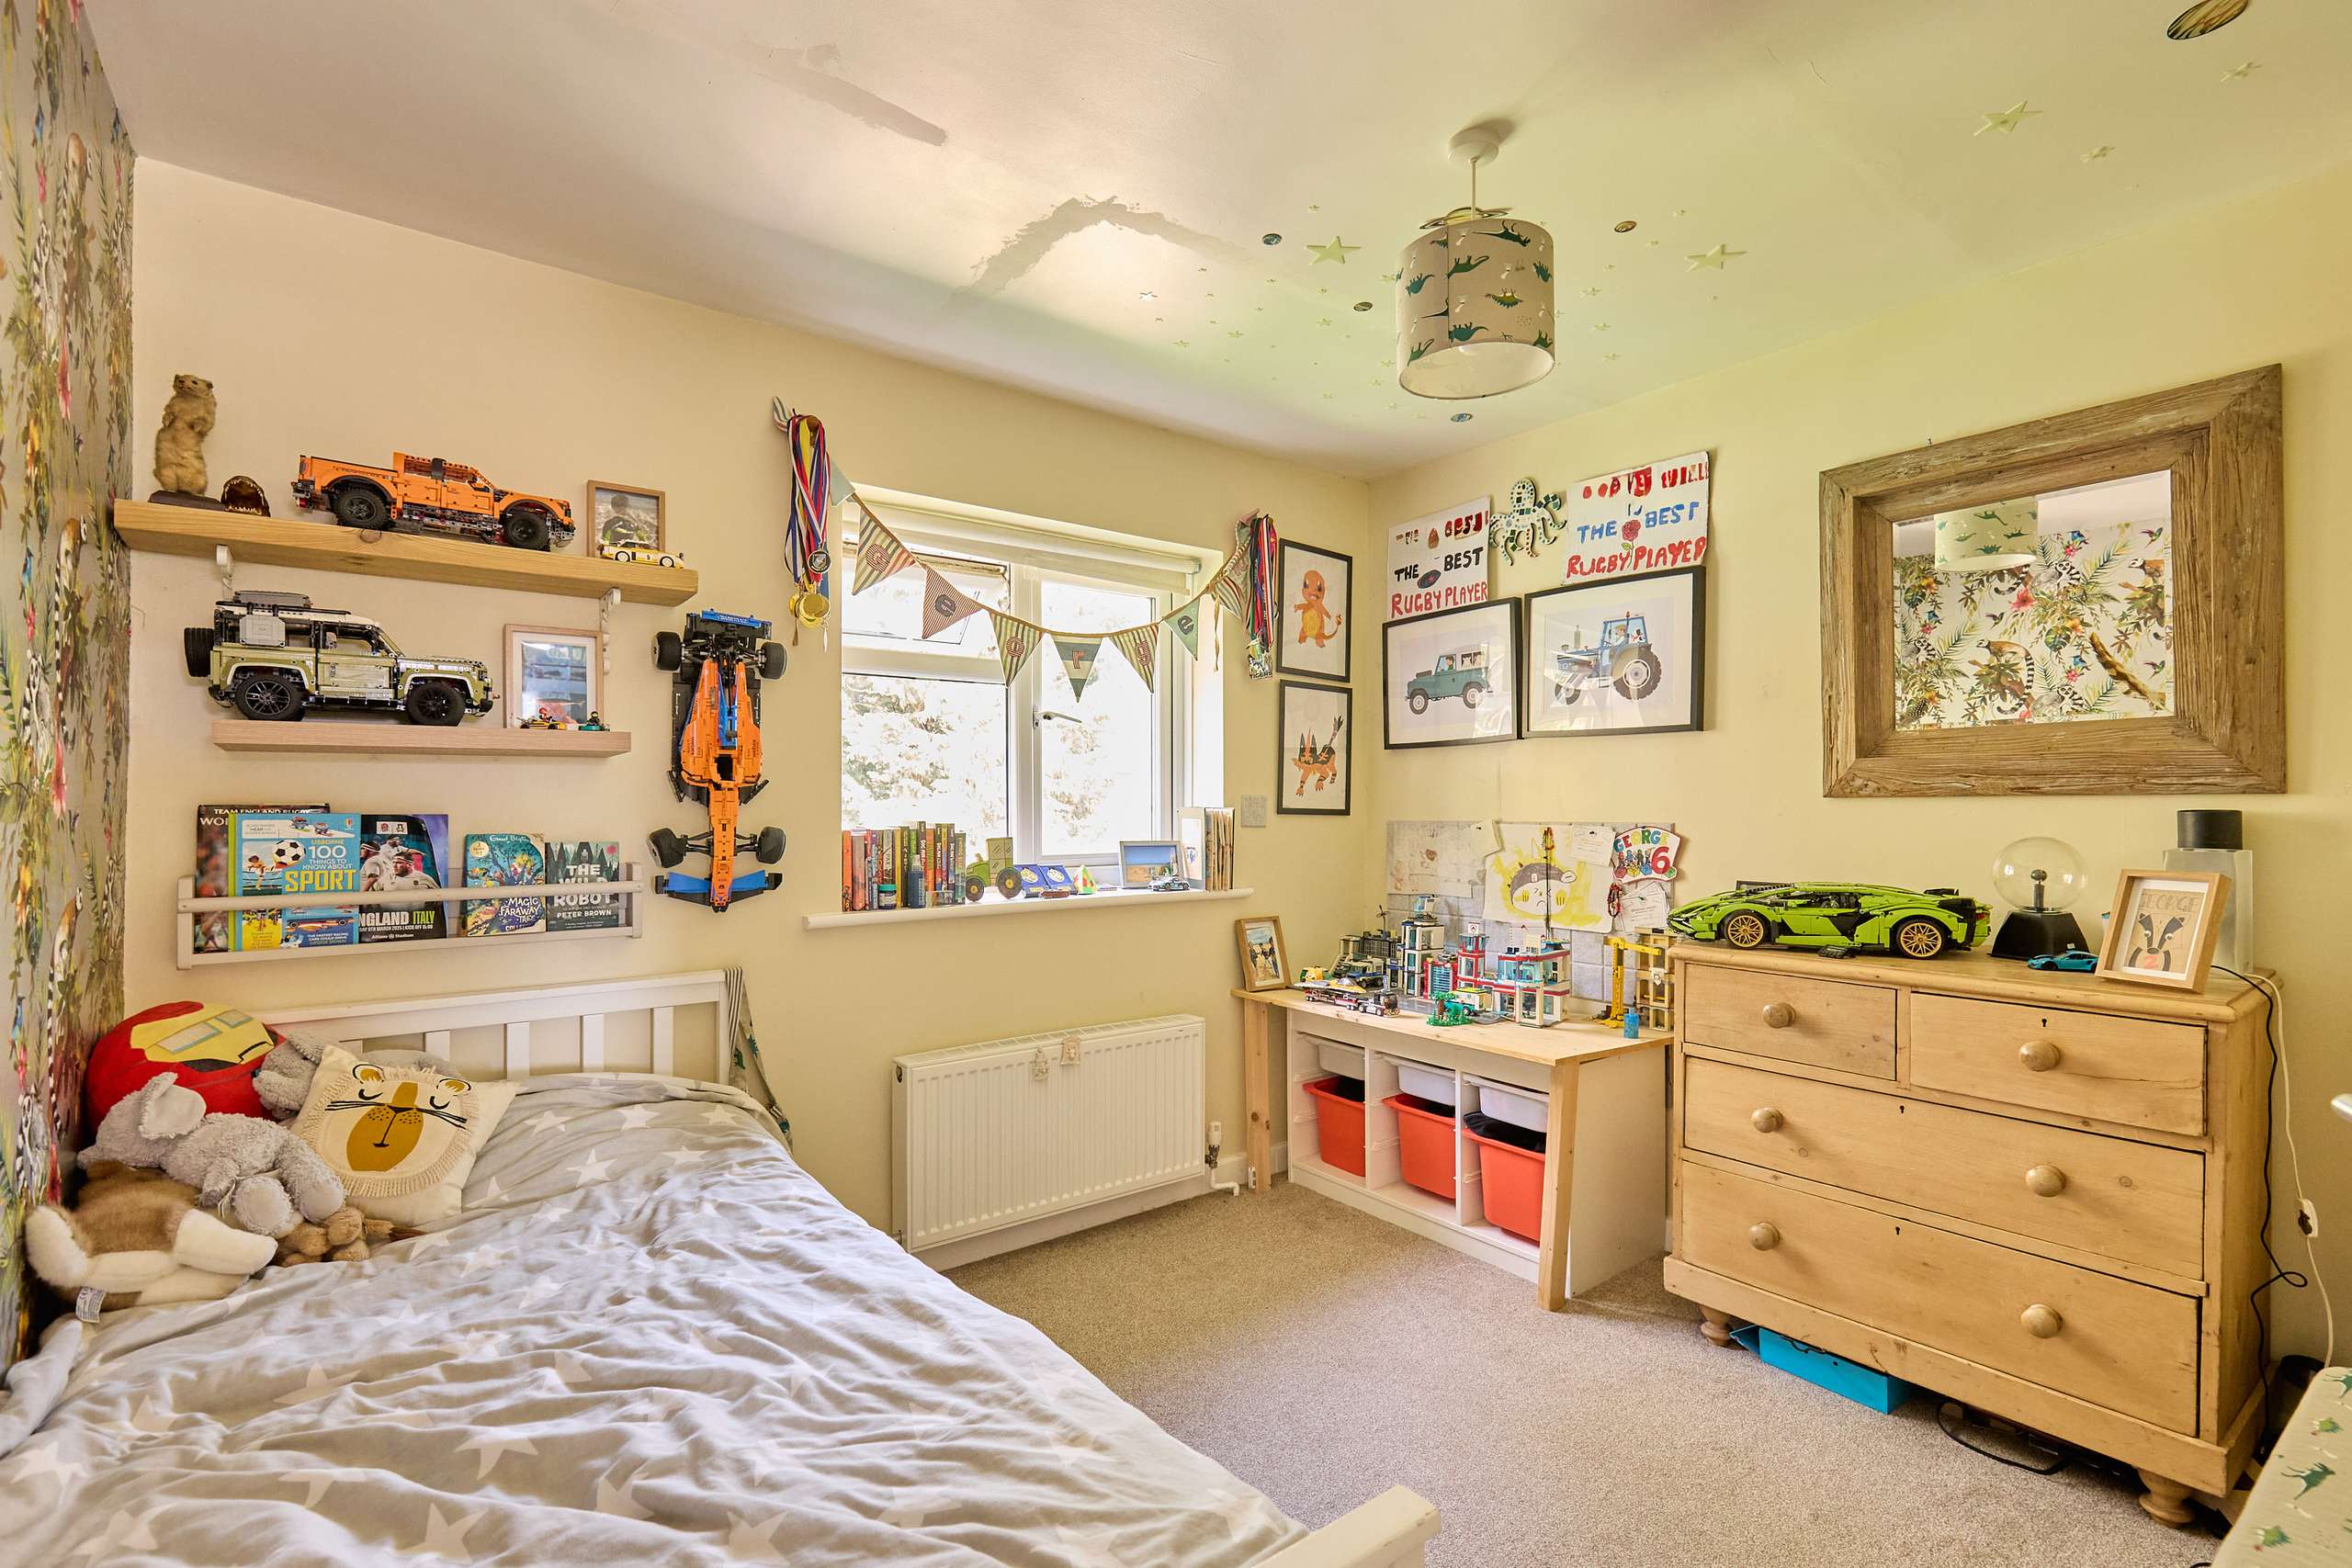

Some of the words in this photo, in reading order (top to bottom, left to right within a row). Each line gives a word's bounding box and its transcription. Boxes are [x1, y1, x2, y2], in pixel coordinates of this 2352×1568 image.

[1577, 520, 1618, 544] THE
[1645, 502, 1700, 529] BEST
[1395, 563, 1419, 581] THE
[1443, 547, 1484, 571] BEST
[1566, 551, 1632, 579] RUGBY
[1633, 536, 1707, 570] PLAYER
[1391, 591, 1442, 618] RUGBY
[1445, 581, 1488, 607] PLAYER
[199, 817, 229, 826] WO
[1612, 829, 1669, 853] GEORGE
[308, 844, 347, 859] 100
[1651, 846, 1670, 874] 6
[566, 863, 601, 875] THE
[284, 869, 356, 892] SPORT
[508, 897, 539, 908] MAGIC
[554, 892, 615, 907] ROBOT
[359, 911, 410, 927] NGLAND
[413, 910, 435, 924] ITALY
[500, 904, 541, 917] FARAWAY
